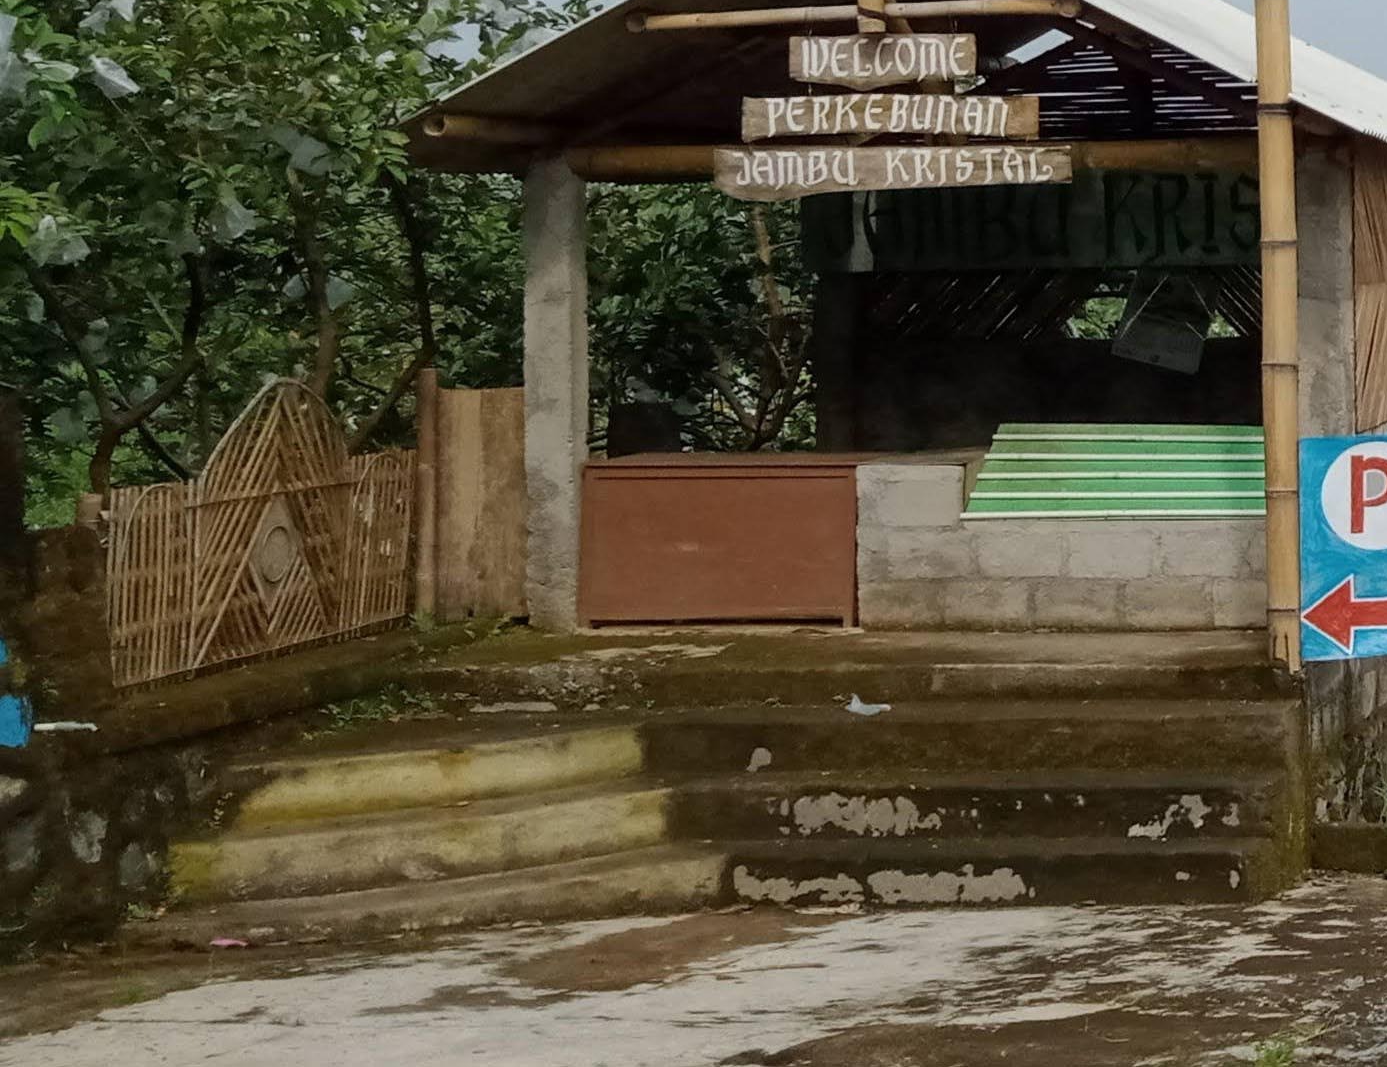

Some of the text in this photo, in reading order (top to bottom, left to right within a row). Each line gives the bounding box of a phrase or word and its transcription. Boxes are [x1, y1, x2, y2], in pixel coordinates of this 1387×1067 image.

[801, 36, 970, 78] WELCOME
[767, 94, 1009, 138] PERKEBUNAN
[734, 147, 1054, 189] JAMBU KRISTAL
